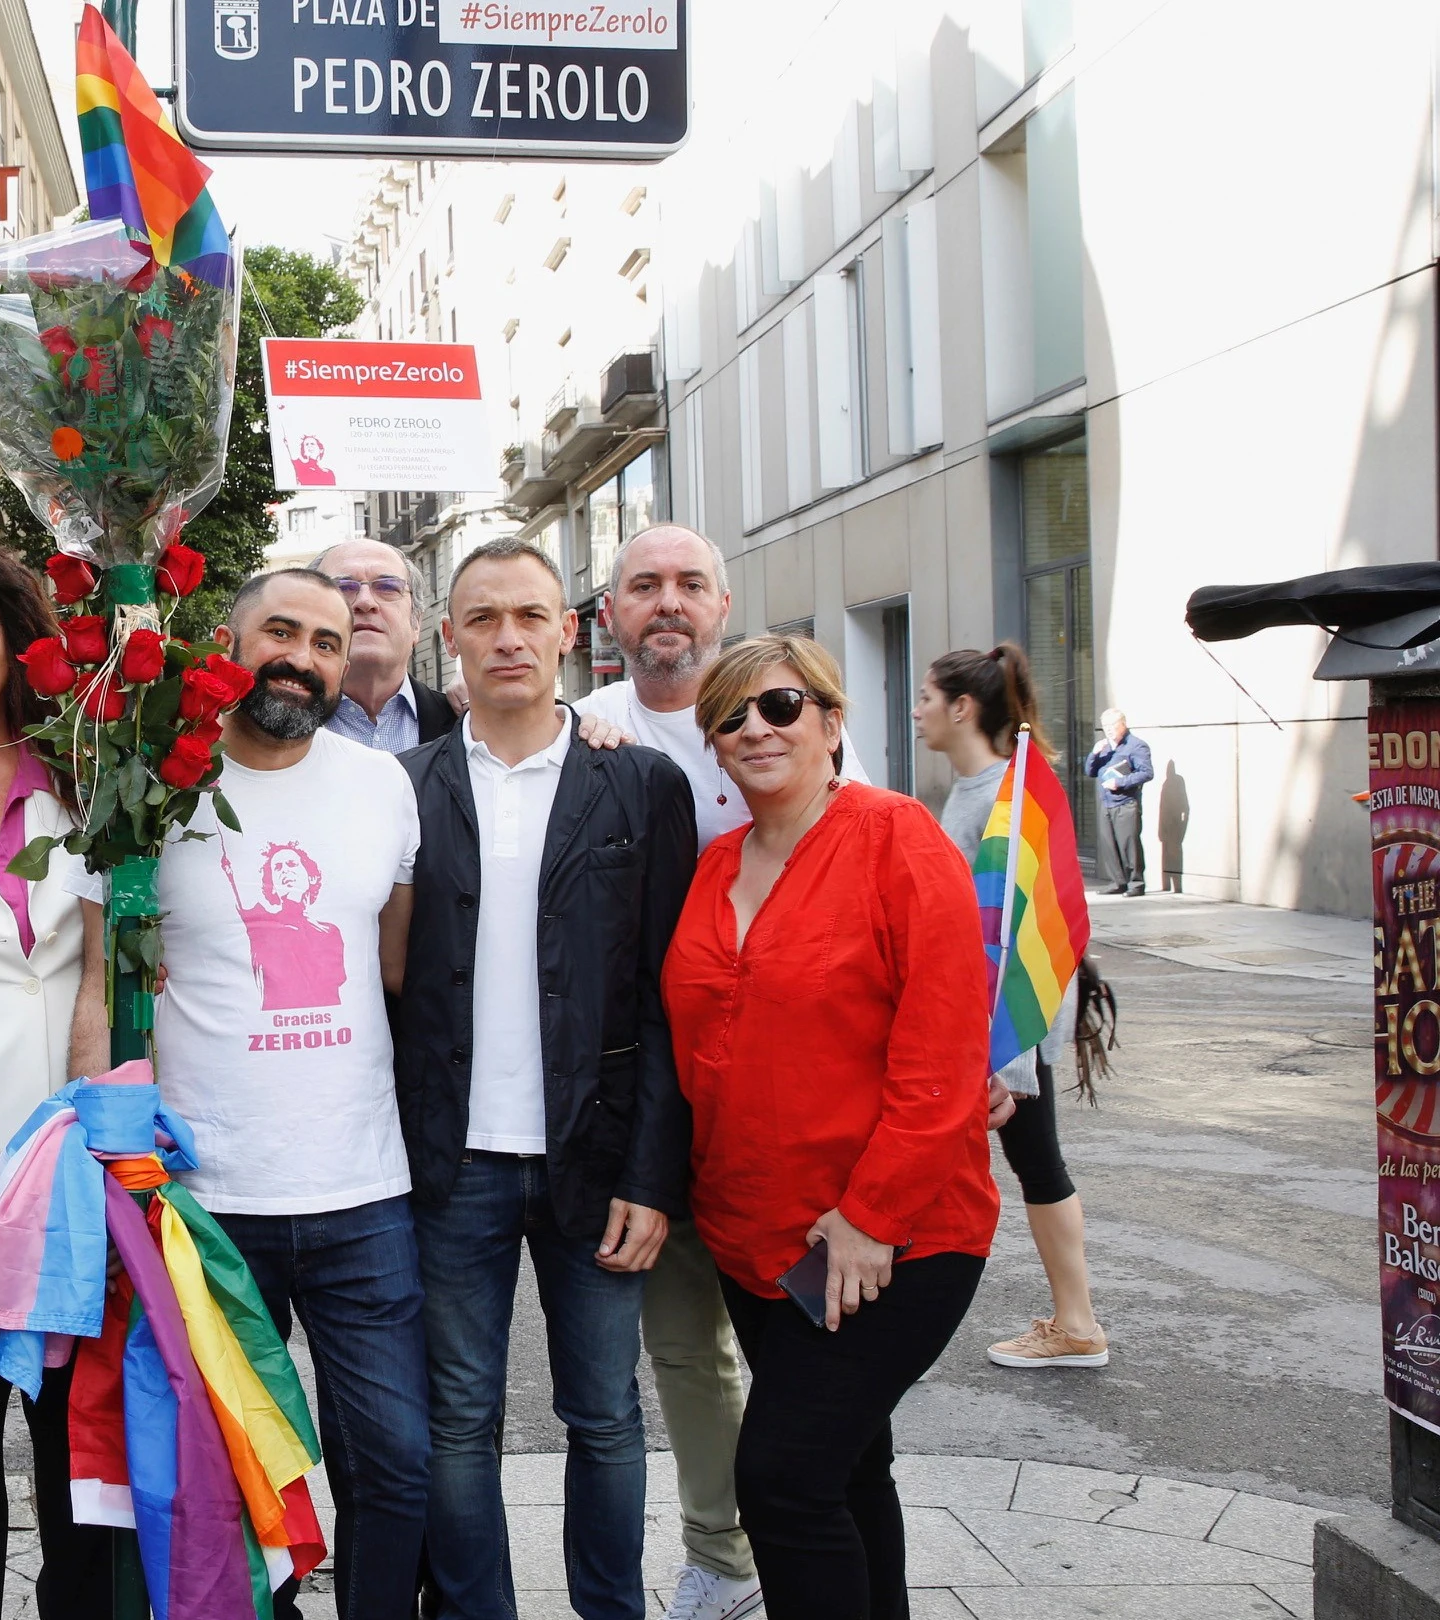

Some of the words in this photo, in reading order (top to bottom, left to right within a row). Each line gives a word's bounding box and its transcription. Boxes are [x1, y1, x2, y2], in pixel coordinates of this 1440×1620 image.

[292, 0, 386, 26] PLAZA
[397, 0, 436, 27] DE
[460, 2, 668, 45] #SiempreZerolo
[293, 57, 452, 118] PEDRO
[470, 61, 650, 123] ZEROLO
[285, 359, 464, 385] #SiempreZerolo
[349, 417, 391, 429] PEDRO
[394, 417, 442, 430] ZEROLO
[1395, 785, 1408, 806] DE
[1392, 879, 1437, 916] THE
[272, 1012, 332, 1028] Gracias
[248, 1027, 352, 1051] ZEROLO
[1400, 1155, 1419, 1178] las
